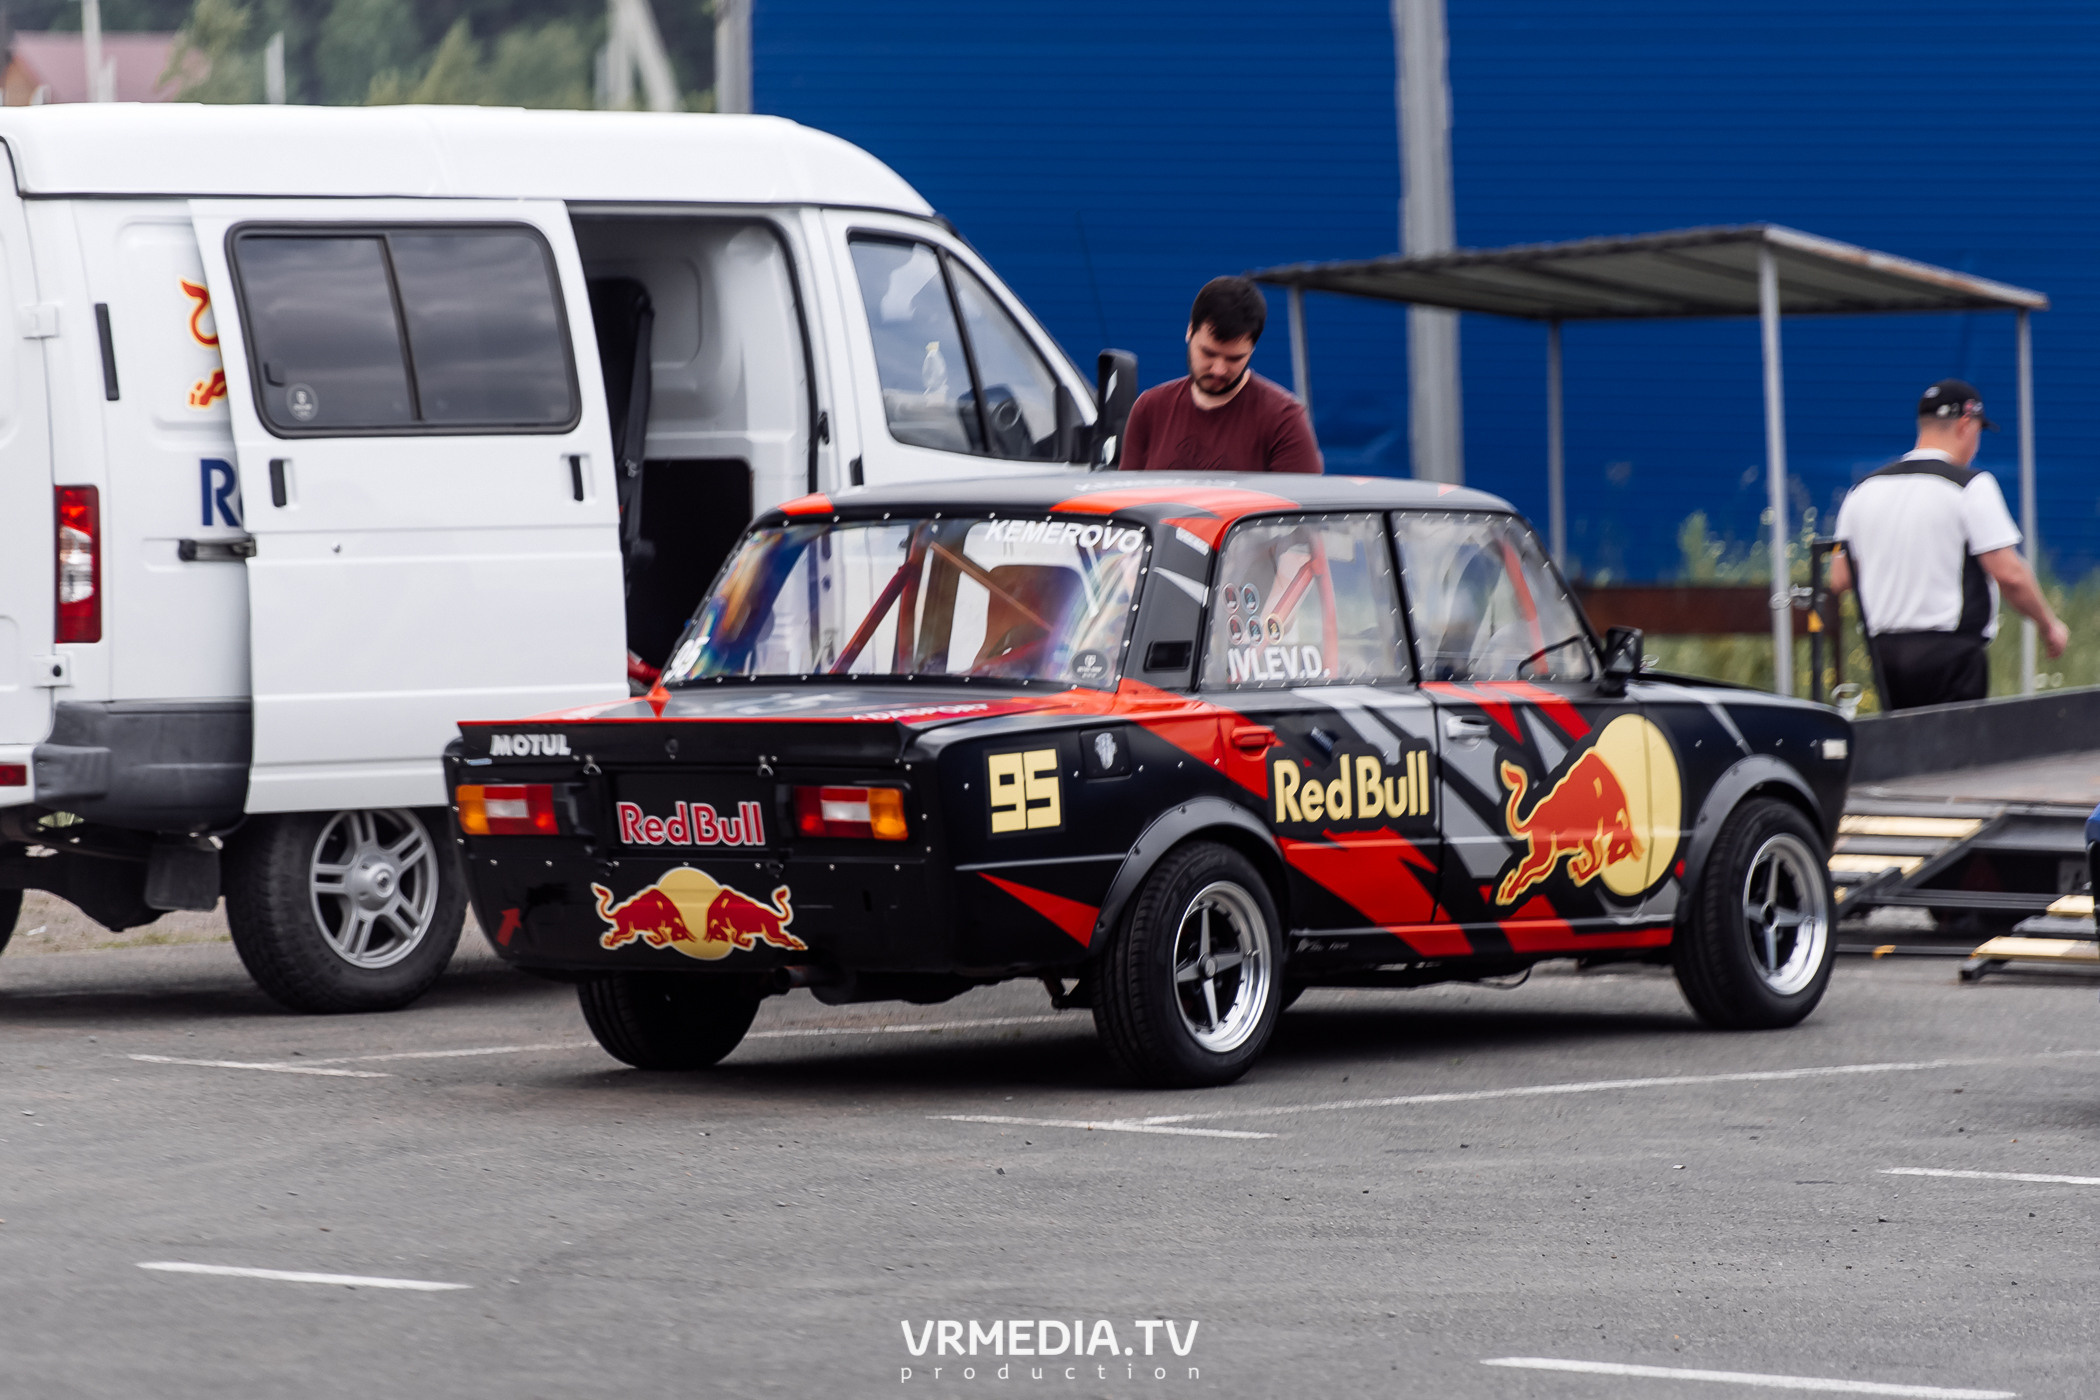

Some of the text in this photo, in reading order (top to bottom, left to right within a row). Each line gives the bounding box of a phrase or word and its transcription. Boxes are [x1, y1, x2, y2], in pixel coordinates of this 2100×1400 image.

[984, 519, 1145, 554] KEMEROVO
[490, 734, 571, 756] MOTUL
[988, 748, 1061, 833] 95
[1273, 750, 1430, 823] Red Bull
[616, 801, 766, 846] Red Bull
